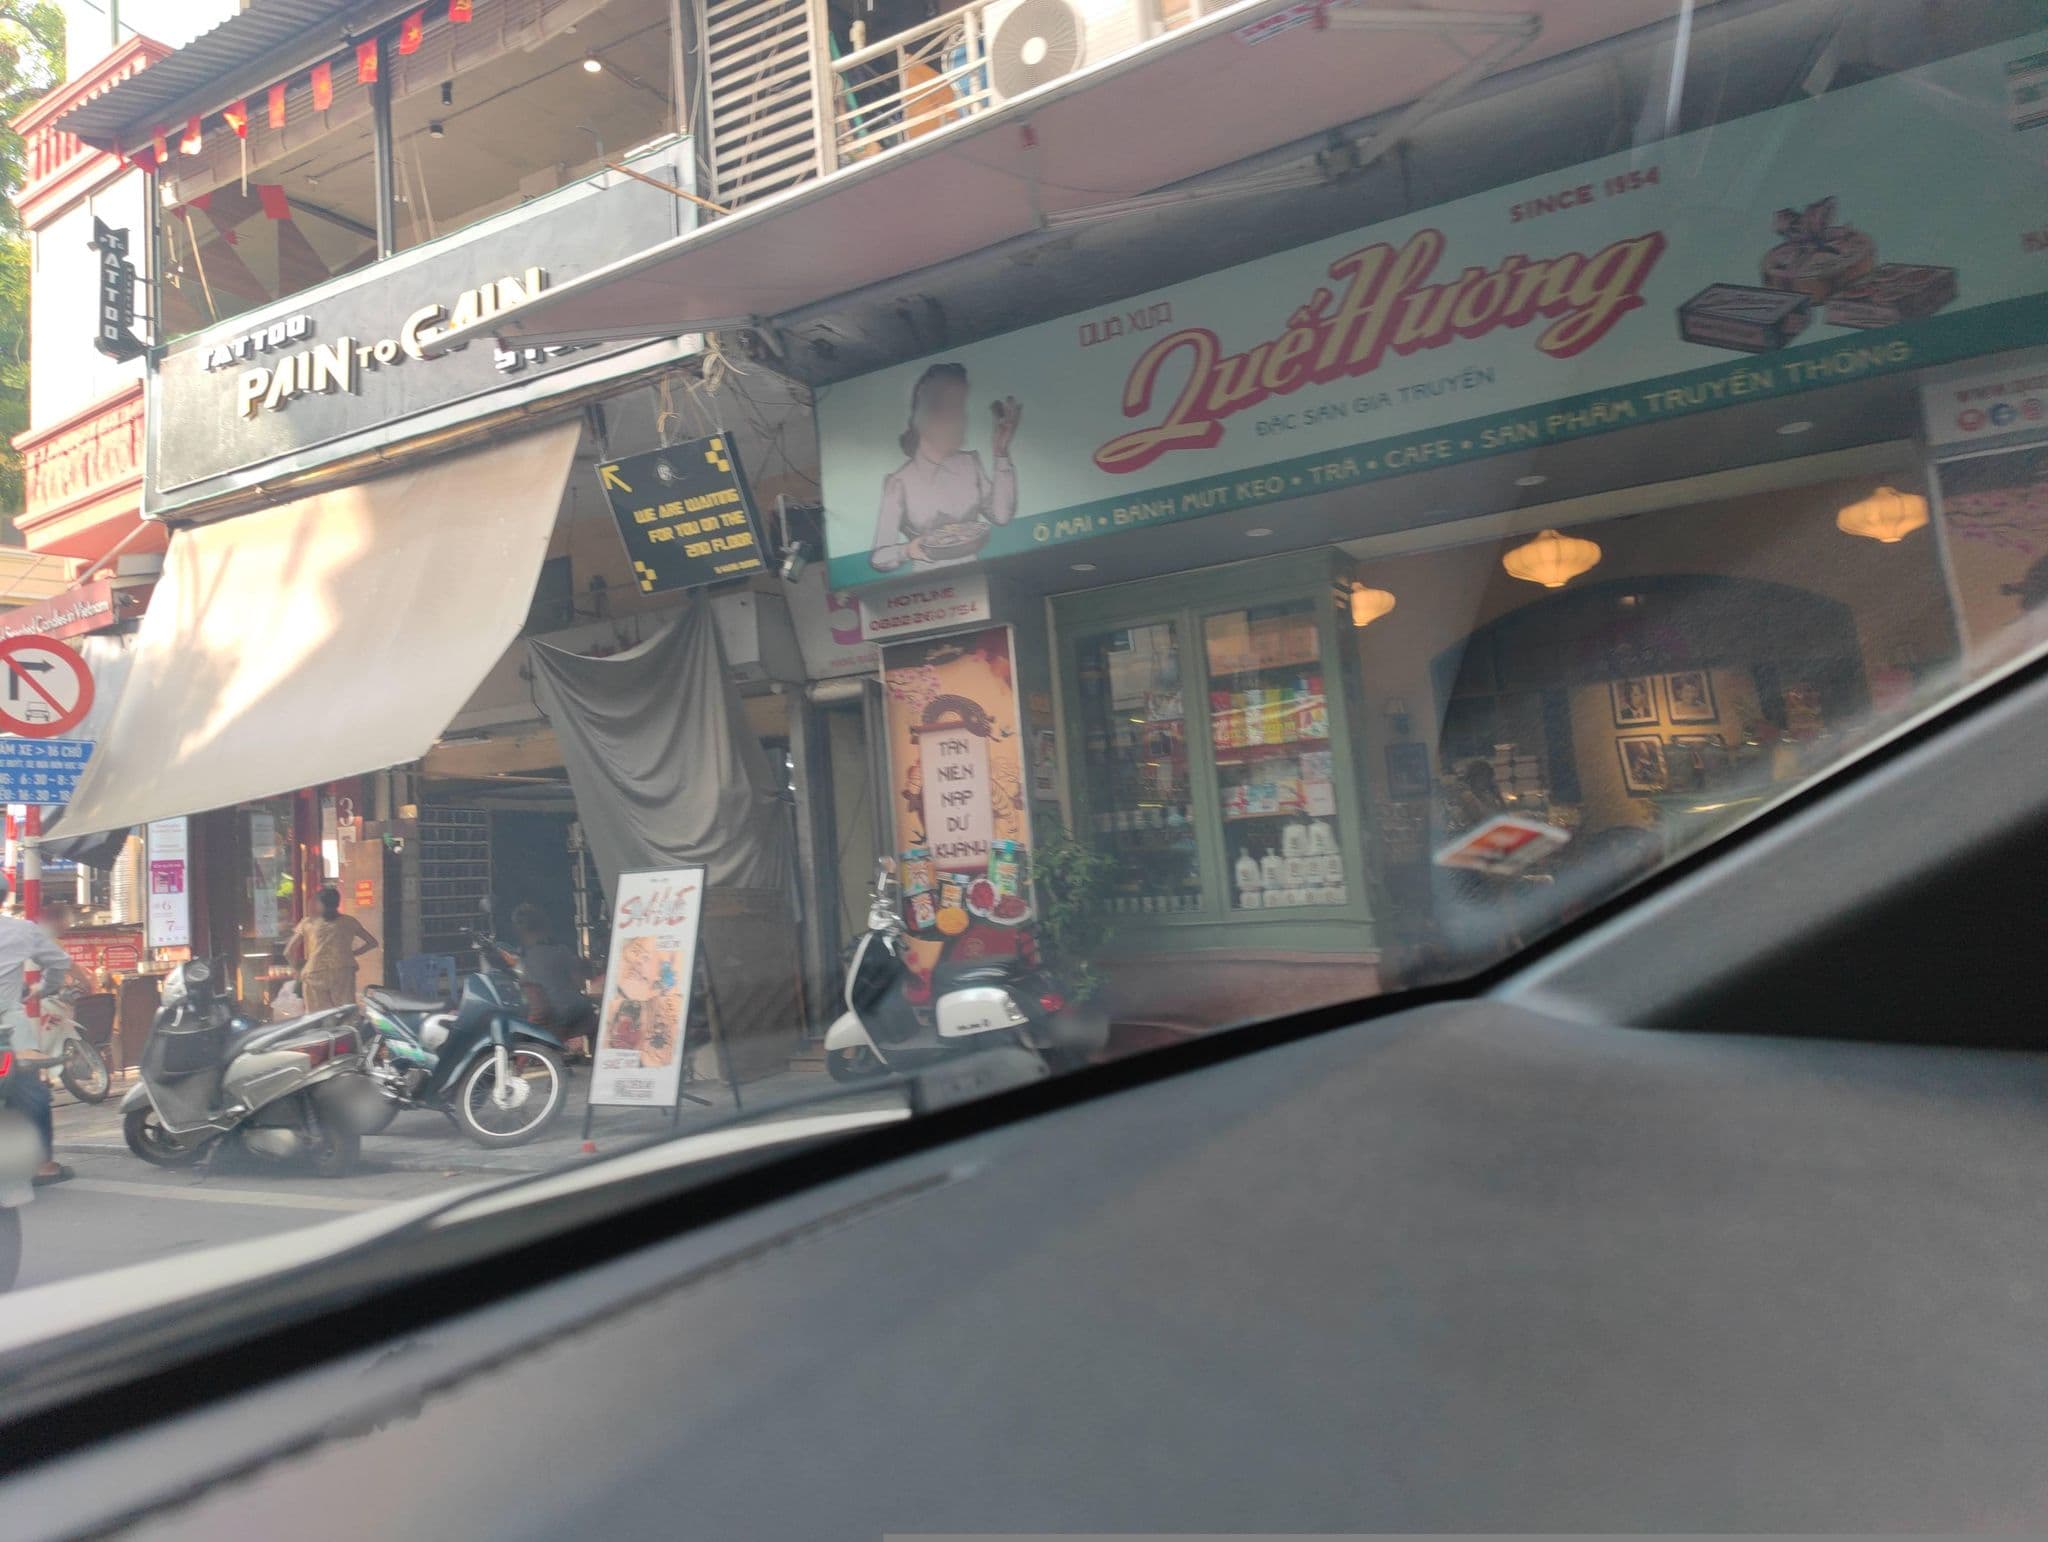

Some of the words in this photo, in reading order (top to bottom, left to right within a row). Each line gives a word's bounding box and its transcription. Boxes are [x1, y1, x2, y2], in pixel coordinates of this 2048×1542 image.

[1510, 184, 1594, 223] SINCE
[104, 233, 121, 340] TATTOO
[201, 314, 312, 371] TATTOO
[237, 336, 357, 420] PAIN
[356, 339, 400, 370] TO
[633, 508, 658, 524] WE
[658, 501, 686, 519] ARE
[1055, 515, 1093, 539] MAI
[648, 527, 675, 543] FOR
[888, 586, 956, 608] HOTLINE
